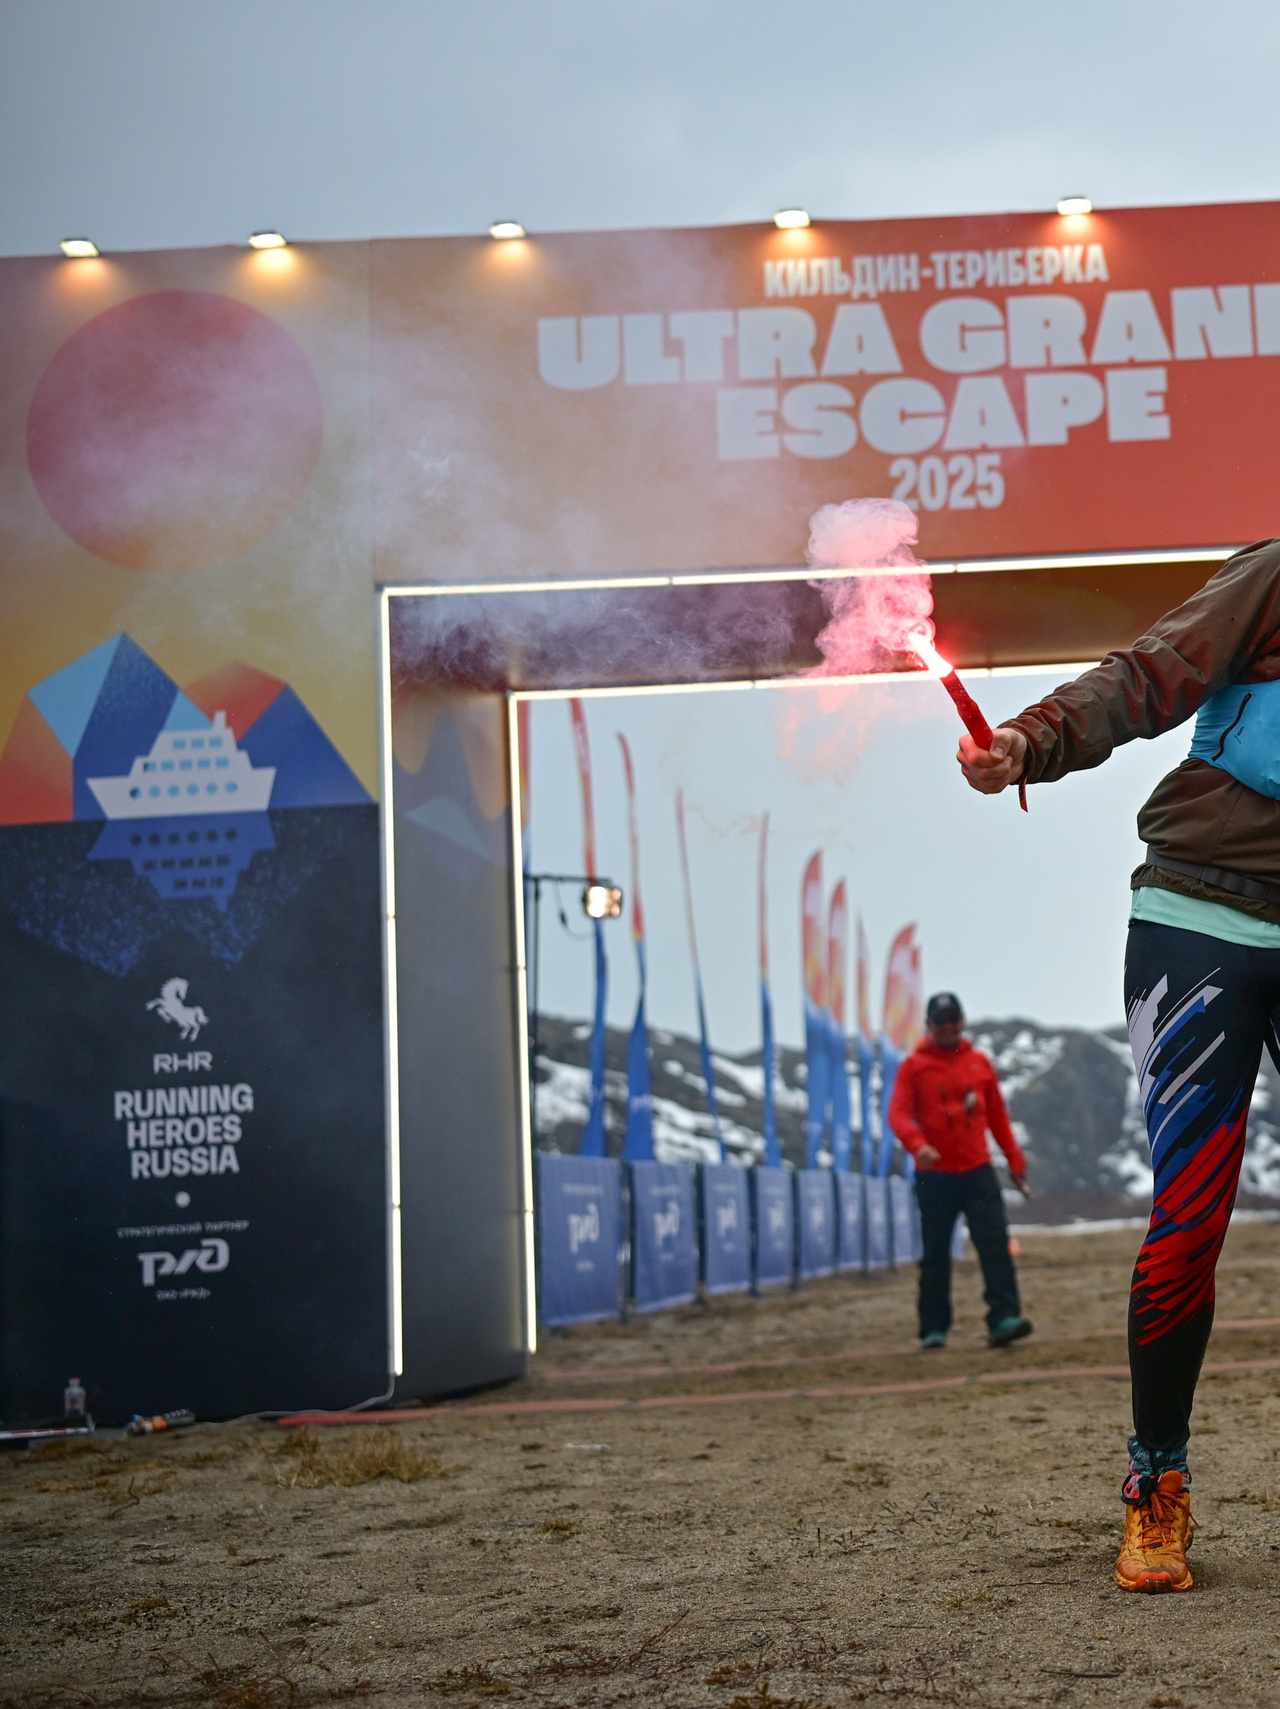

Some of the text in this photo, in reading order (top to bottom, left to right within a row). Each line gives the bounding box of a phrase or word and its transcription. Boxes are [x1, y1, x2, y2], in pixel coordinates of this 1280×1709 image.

[764, 243, 1109, 299] КИЛЬДИН-ТЕРИБЕРКА
[537, 302, 903, 390] ULTRA
[716, 366, 1172, 461] ESCAPE
[889, 453, 1006, 512] 2025
[153, 1051, 213, 1074] RHR
[114, 1083, 254, 1120] RUNNING
[126, 1115, 242, 1149] HEROES
[130, 1145, 240, 1179] RUSSIA
